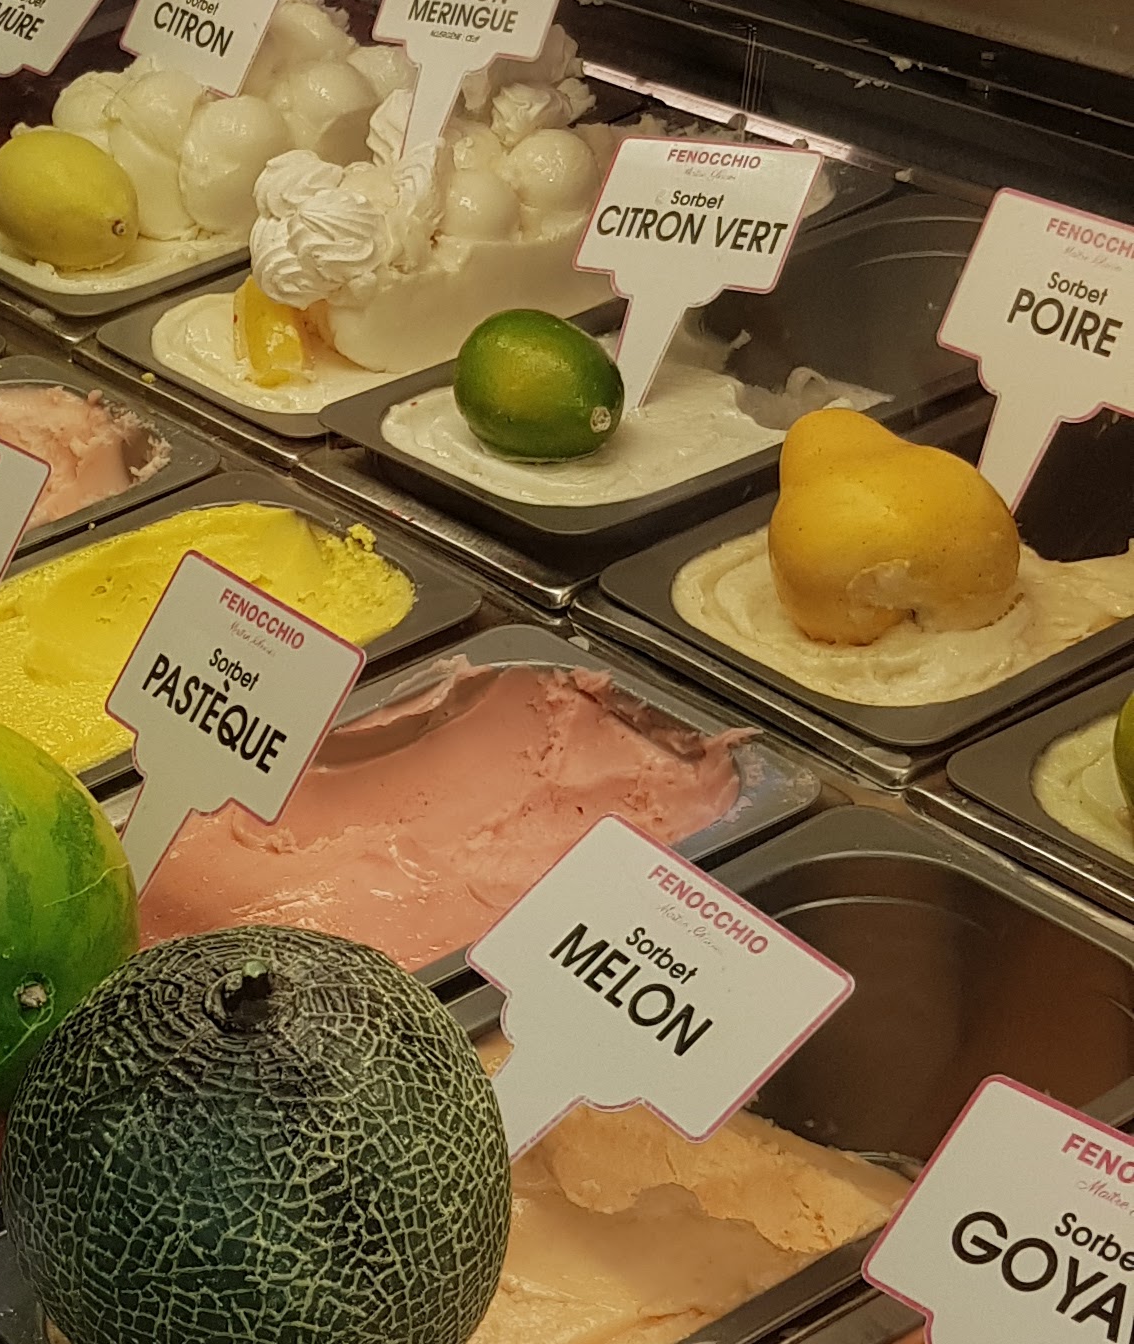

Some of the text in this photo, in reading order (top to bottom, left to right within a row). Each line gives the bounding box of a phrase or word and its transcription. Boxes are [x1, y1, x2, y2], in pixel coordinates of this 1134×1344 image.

[153, 1, 234, 58] CITRON
[666, 149, 762, 170] FENOCCHIO
[670, 190, 724, 210] Sorbet
[596, 205, 789, 255] CITRON VERT
[1047, 271, 1109, 306] Sorbet
[1006, 287, 1124, 358] POIRE
[218, 587, 306, 651] FENOCCHIO
[208, 647, 261, 692] Sorbet
[141, 652, 288, 775] PASTÈQUE
[646, 864, 769, 955] FENOCCHIO
[625, 926, 699, 985] Sorbet
[548, 922, 714, 1057] MELON
[1054, 1212, 1134, 1272] Sorbe
